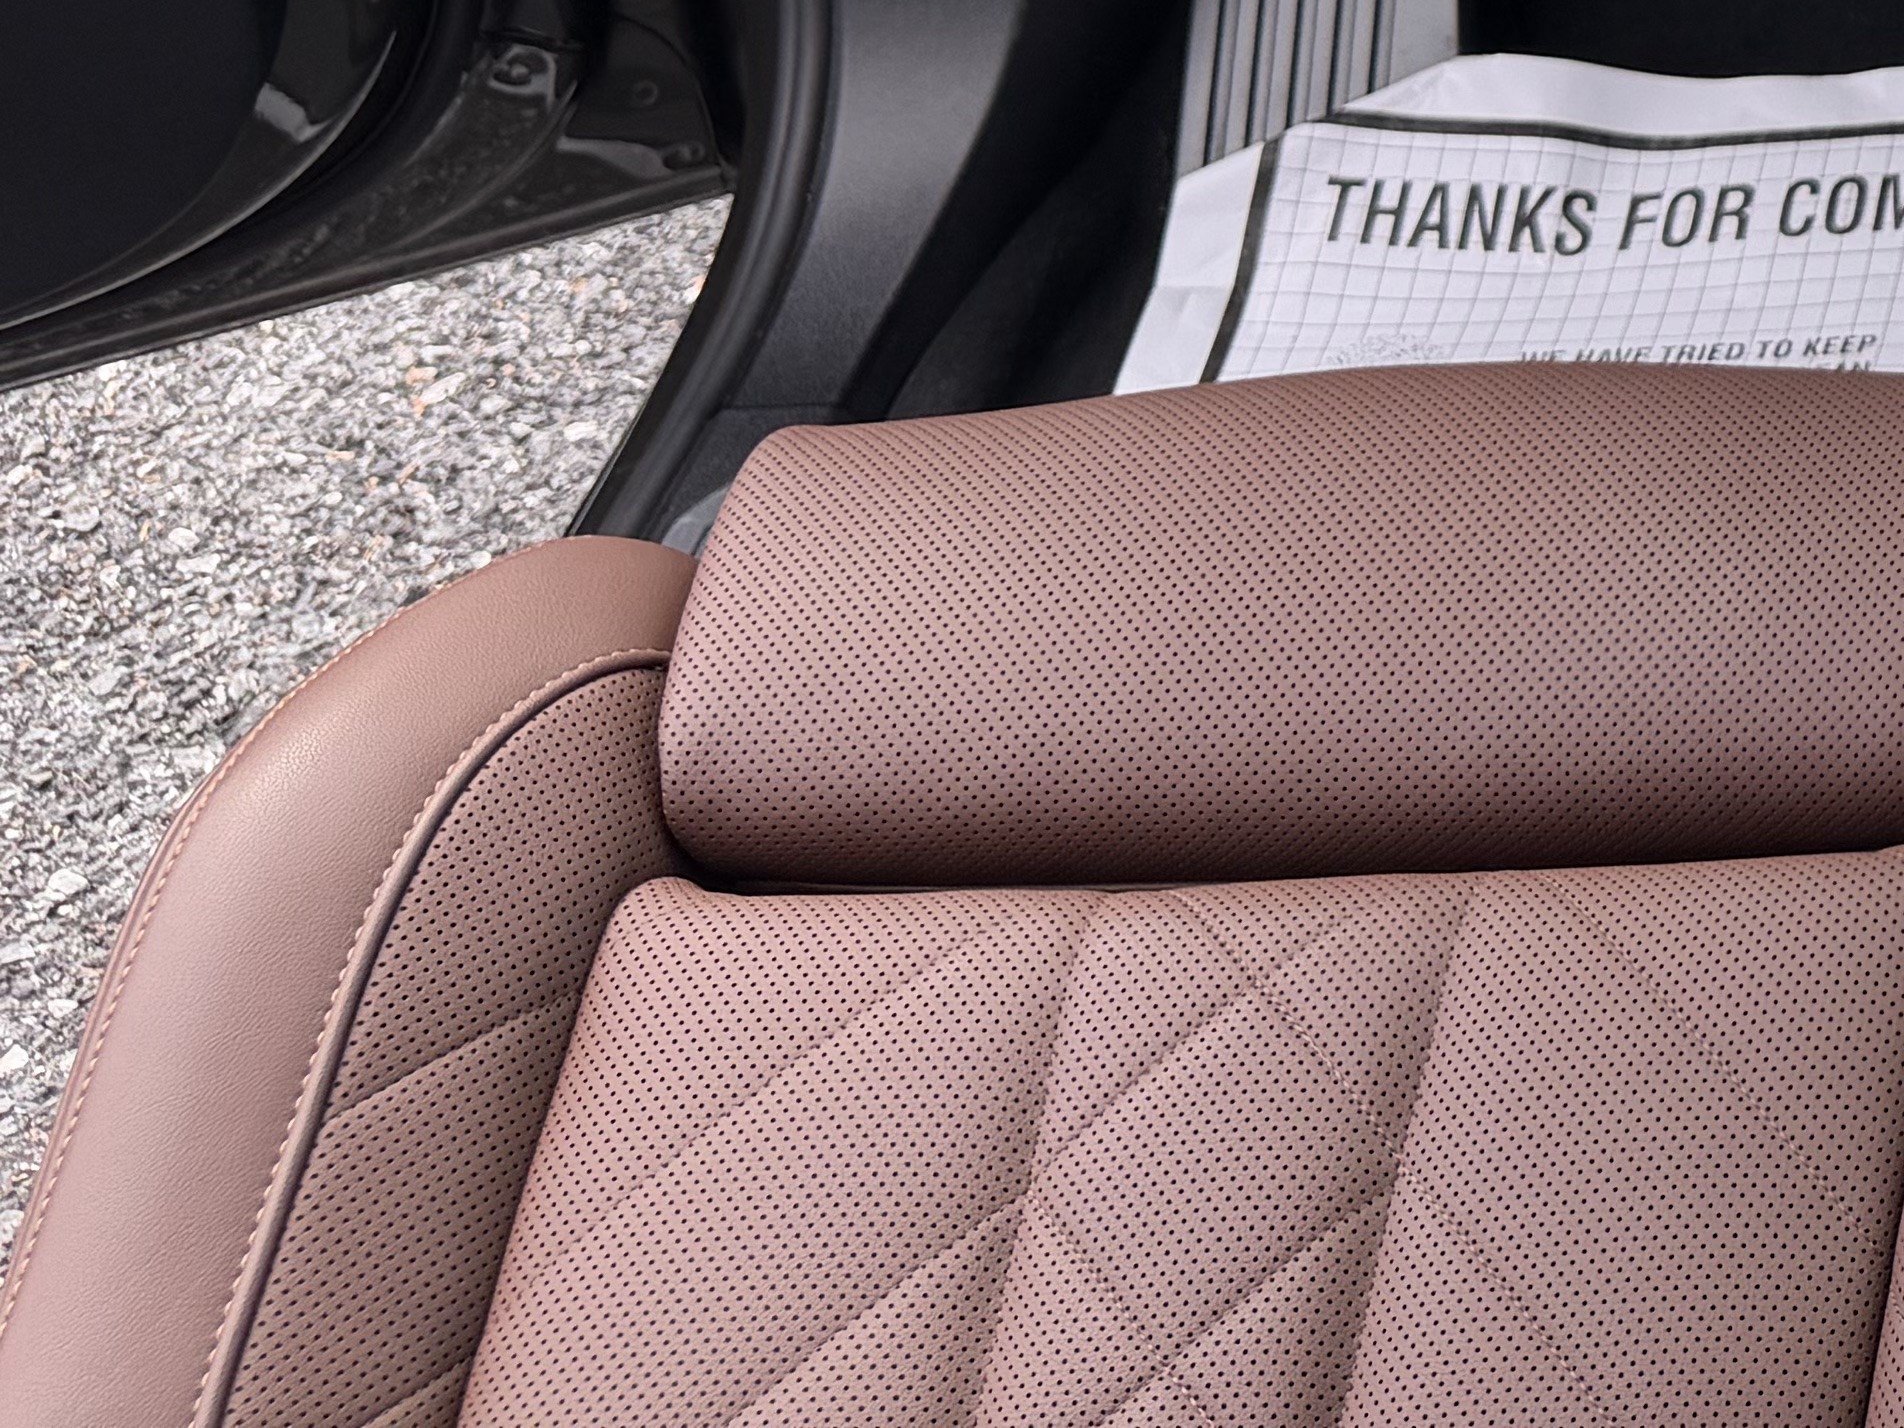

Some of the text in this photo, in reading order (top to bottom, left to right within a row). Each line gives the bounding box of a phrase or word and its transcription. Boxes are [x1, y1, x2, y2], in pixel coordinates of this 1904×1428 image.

[1324, 172, 1599, 259] THANKS
[1617, 182, 1757, 254] FOR
[1660, 341, 1746, 365] TRIED
[1756, 338, 1794, 360] TO
[1802, 333, 1878, 358] KEEP
